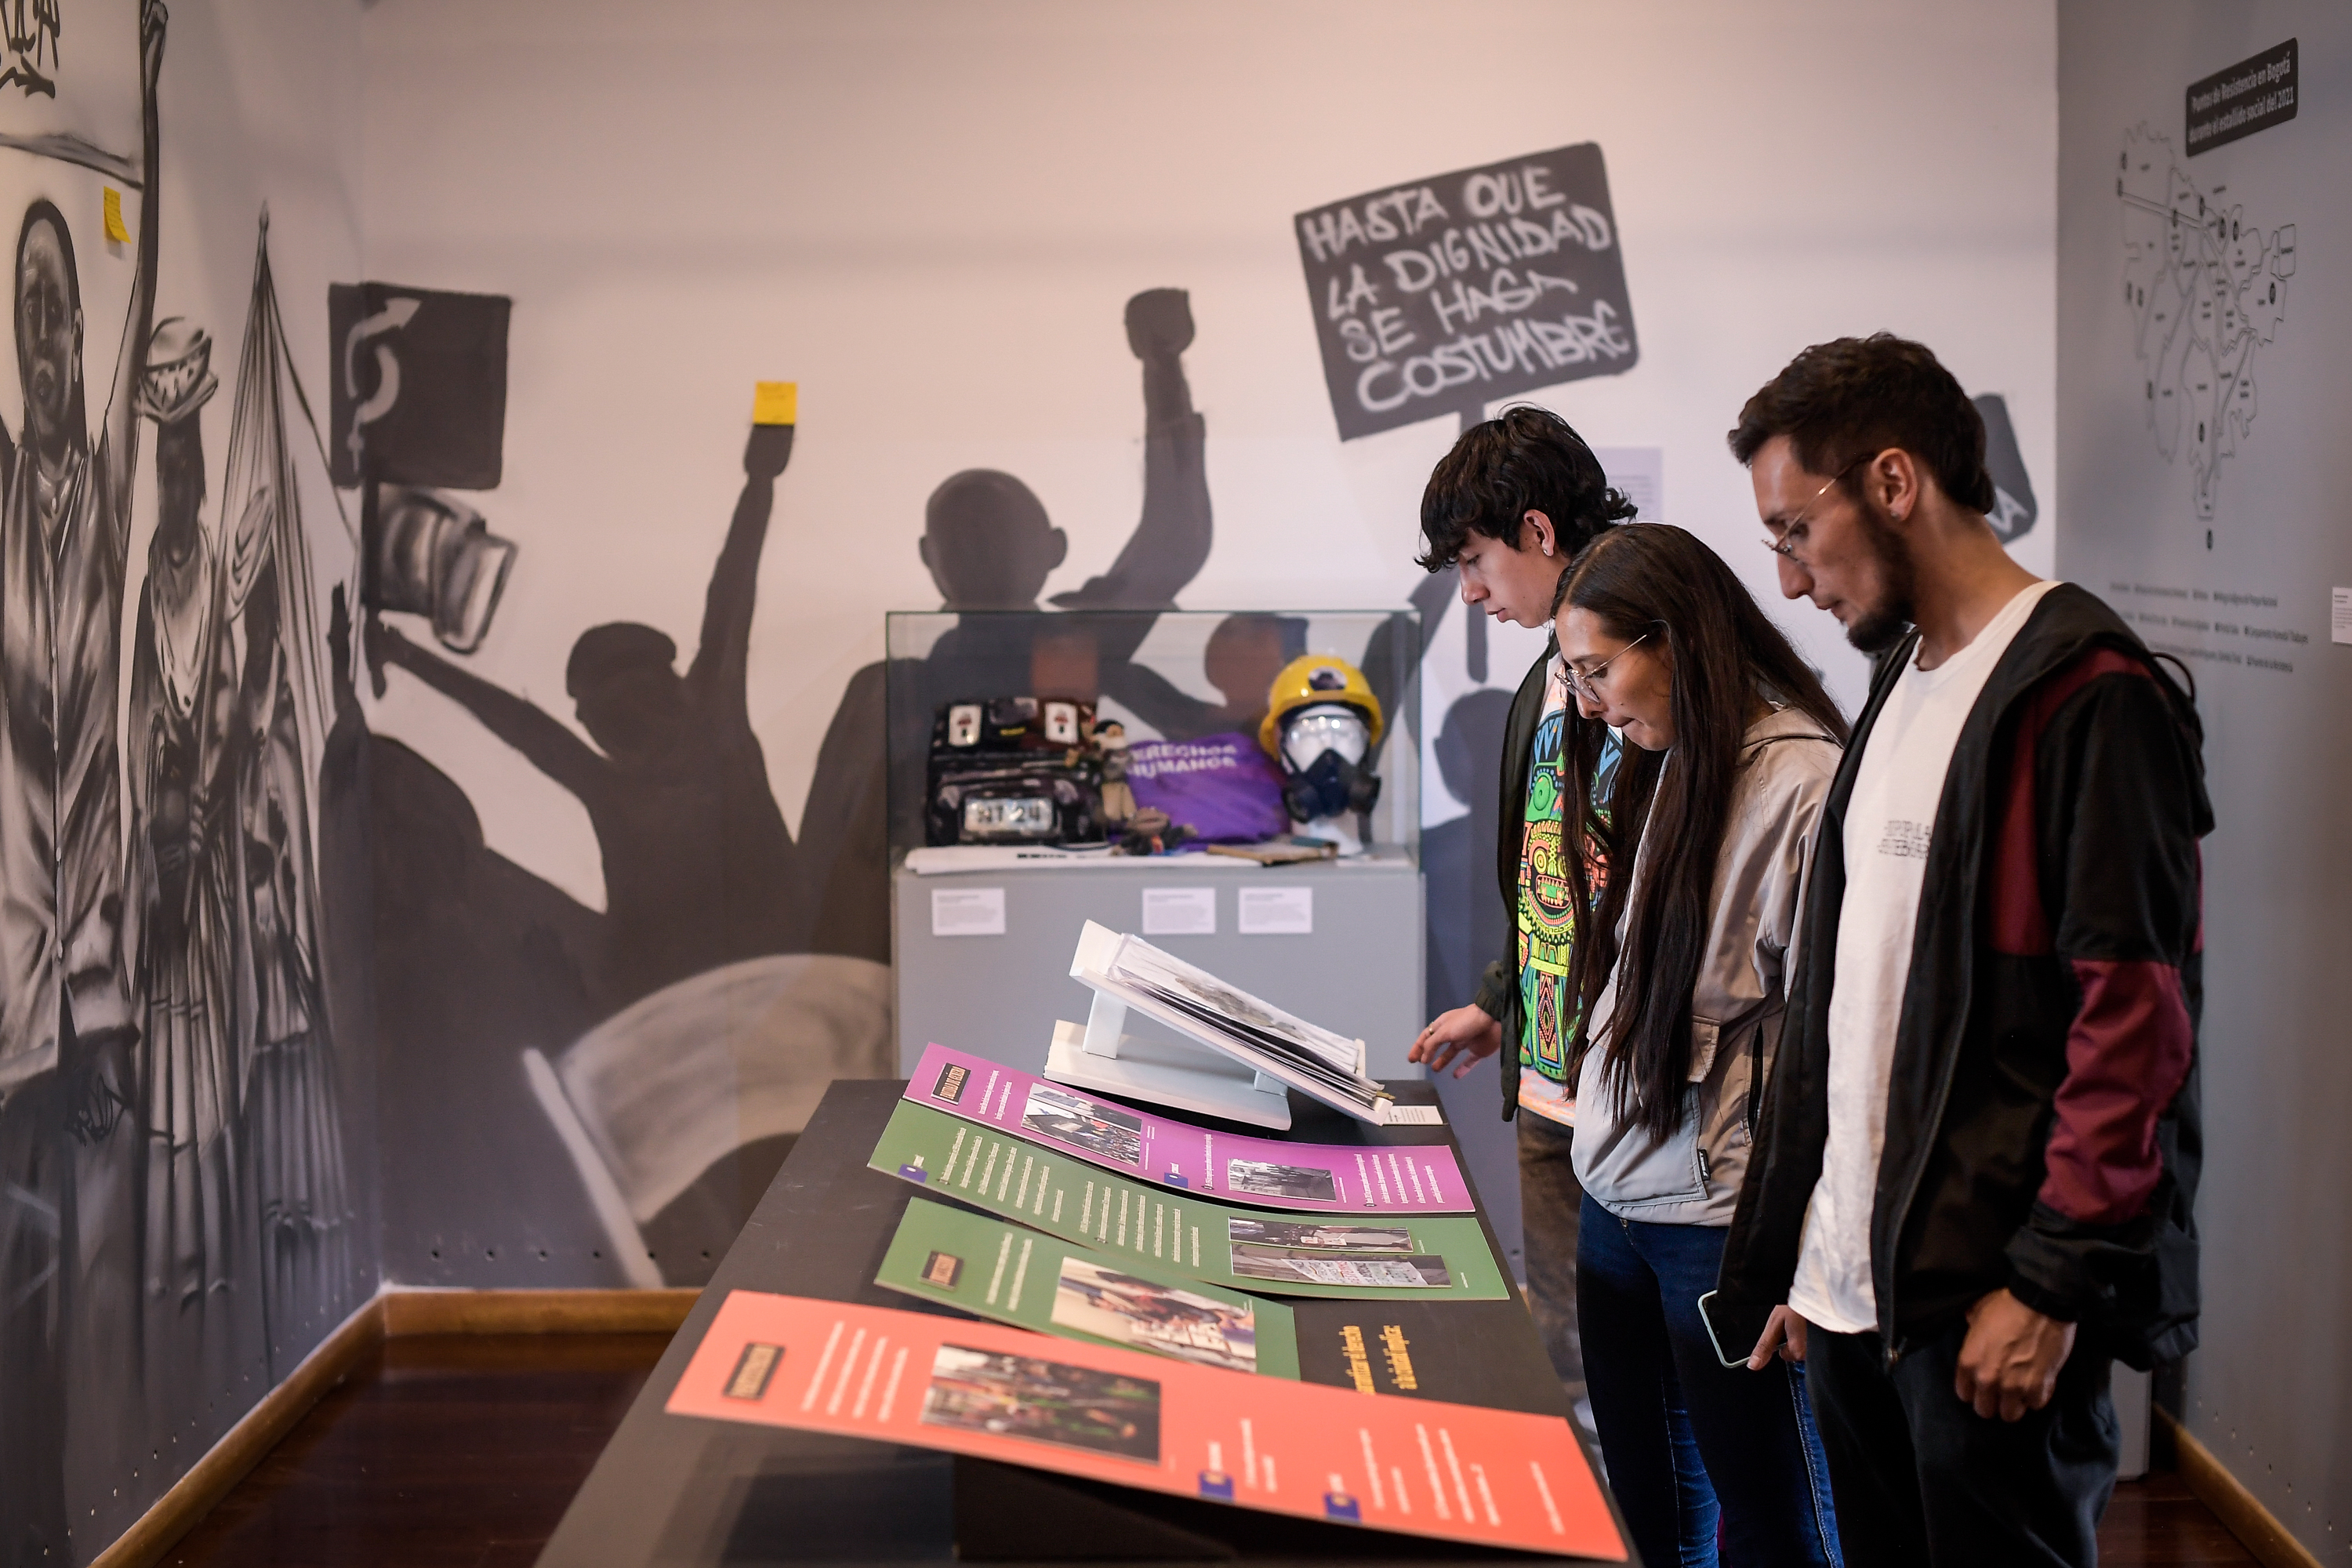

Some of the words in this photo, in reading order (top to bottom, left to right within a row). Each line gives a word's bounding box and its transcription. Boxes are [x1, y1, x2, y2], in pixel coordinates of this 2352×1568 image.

[2221, 69, 2256, 100] Resistencia
[2258, 69, 2267, 85] en
[2267, 50, 2290, 83] Bogotá
[2247, 96, 2267, 122] social
[2267, 92, 2277, 113] del
[2278, 85, 2293, 109] 2021
[1303, 187, 1449, 263] HASTA
[1328, 264, 1380, 321] LA
[1384, 204, 1612, 293] DIGNIDAD
[1340, 307, 1416, 361] SE
[1431, 268, 1578, 335] HAGA
[1357, 299, 1631, 412] COSTUMBRE
[1130, 744, 1237, 760] ERECHOS
